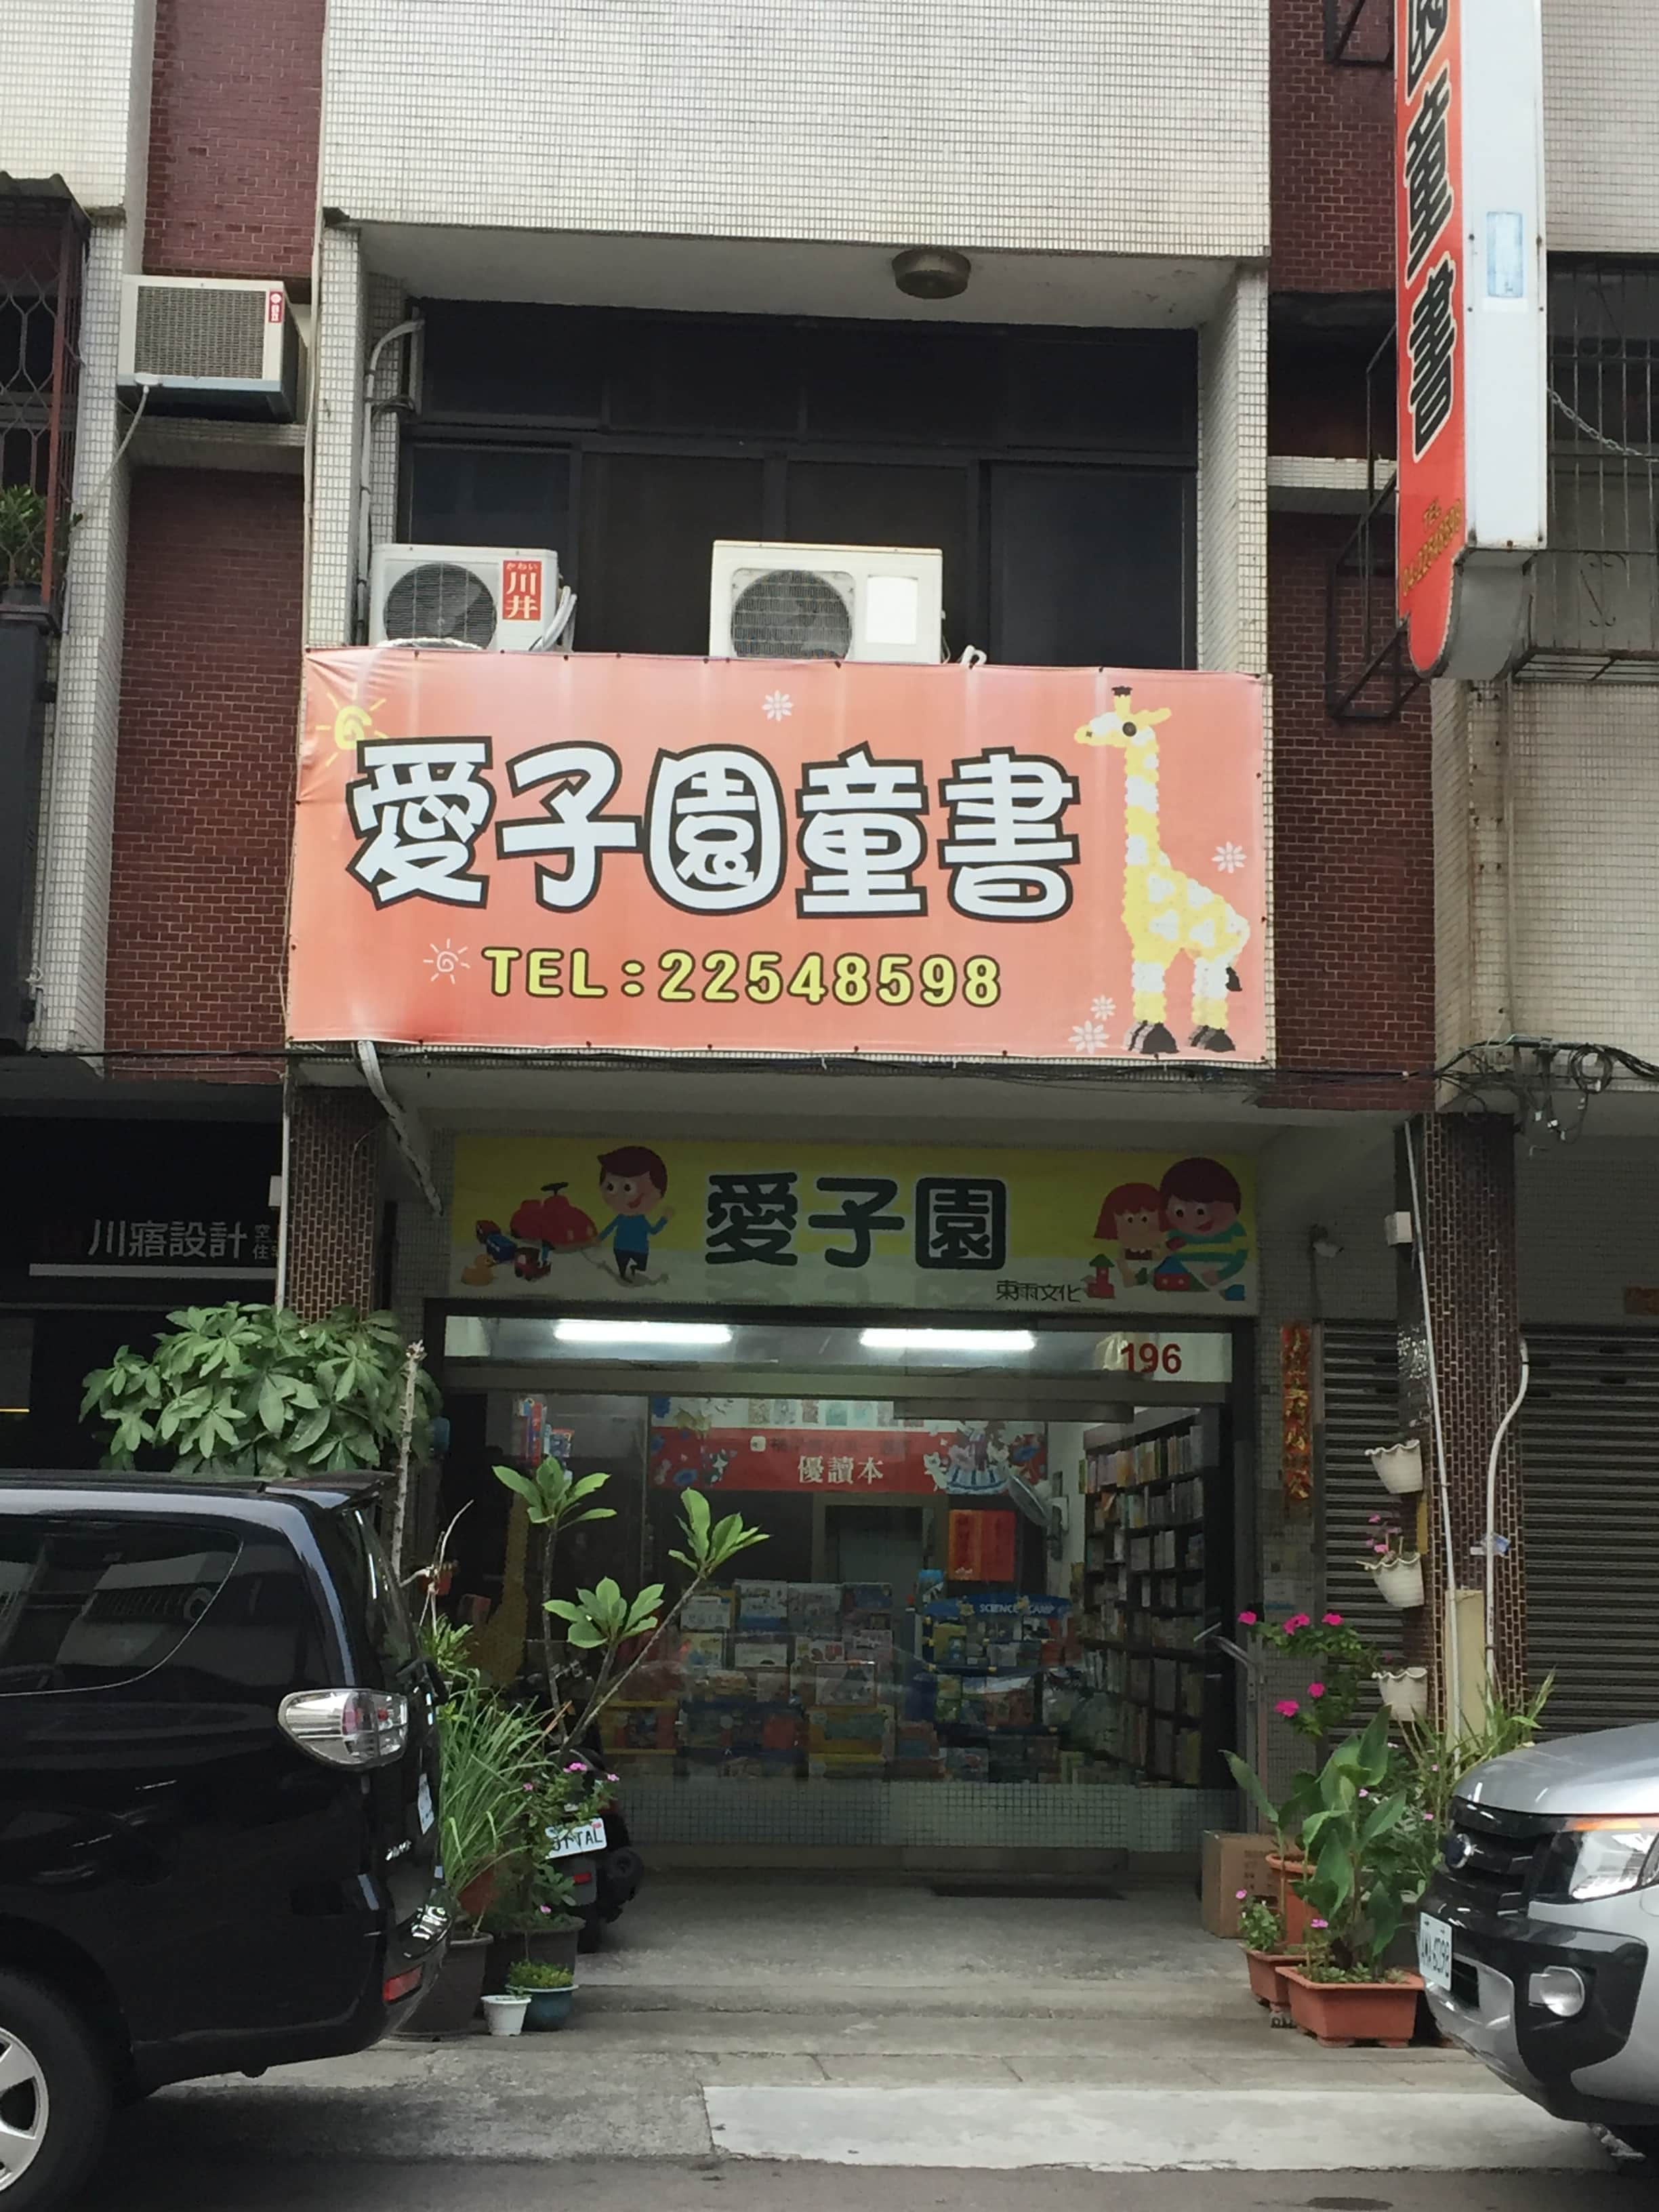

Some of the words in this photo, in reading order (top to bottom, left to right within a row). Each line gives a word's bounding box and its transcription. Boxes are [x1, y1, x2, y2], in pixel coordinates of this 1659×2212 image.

[506, 572, 538, 619] 川井
[346, 737, 1080, 922] 愛子園童書
[705, 1172, 1006, 1270] 愛子園
[996, 1280, 1082, 1303] 東雨文化
[1121, 1343, 1182, 1374] 196
[798, 1456, 884, 1484] 優讀本
